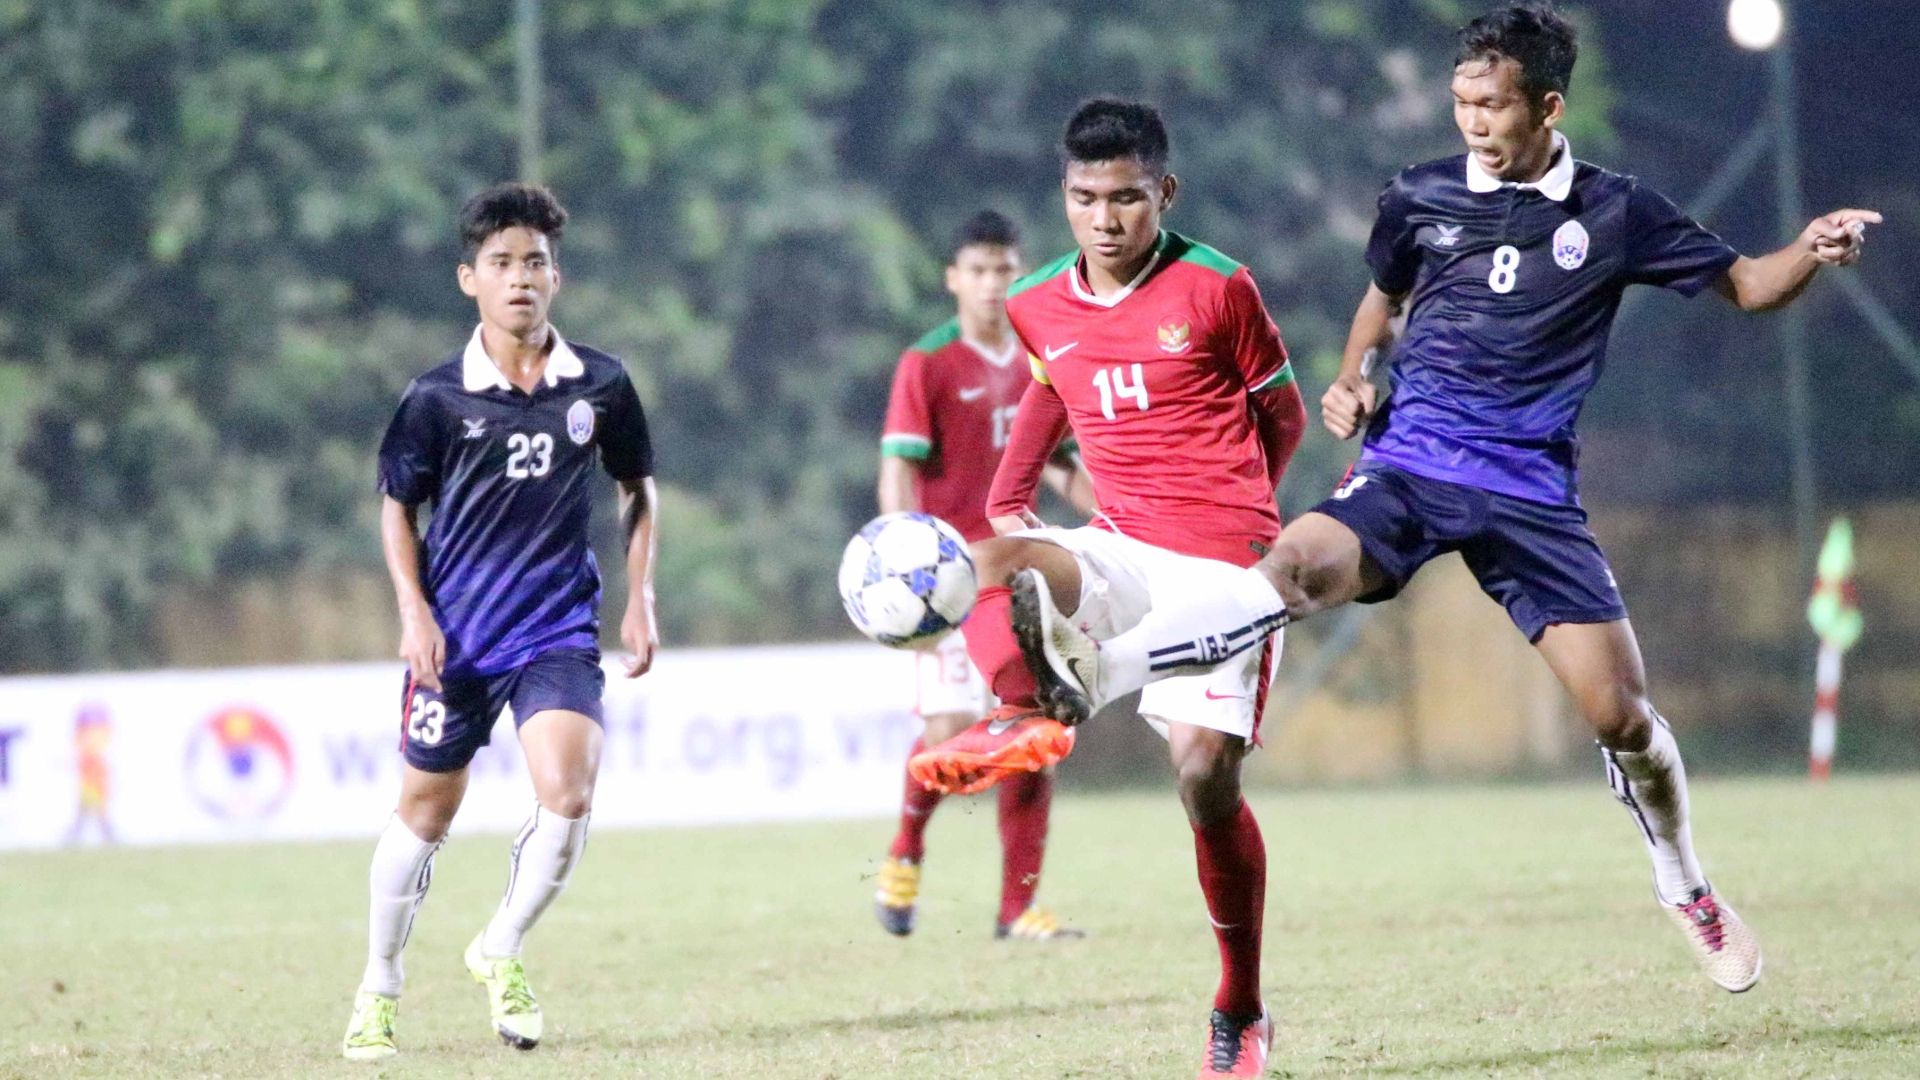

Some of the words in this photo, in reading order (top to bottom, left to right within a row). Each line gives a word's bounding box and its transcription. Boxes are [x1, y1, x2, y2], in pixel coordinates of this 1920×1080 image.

[1488, 244, 1520, 294] 8
[1092, 362, 1150, 421] 14
[506, 432, 554, 479] 23
[407, 693, 446, 745] 23
